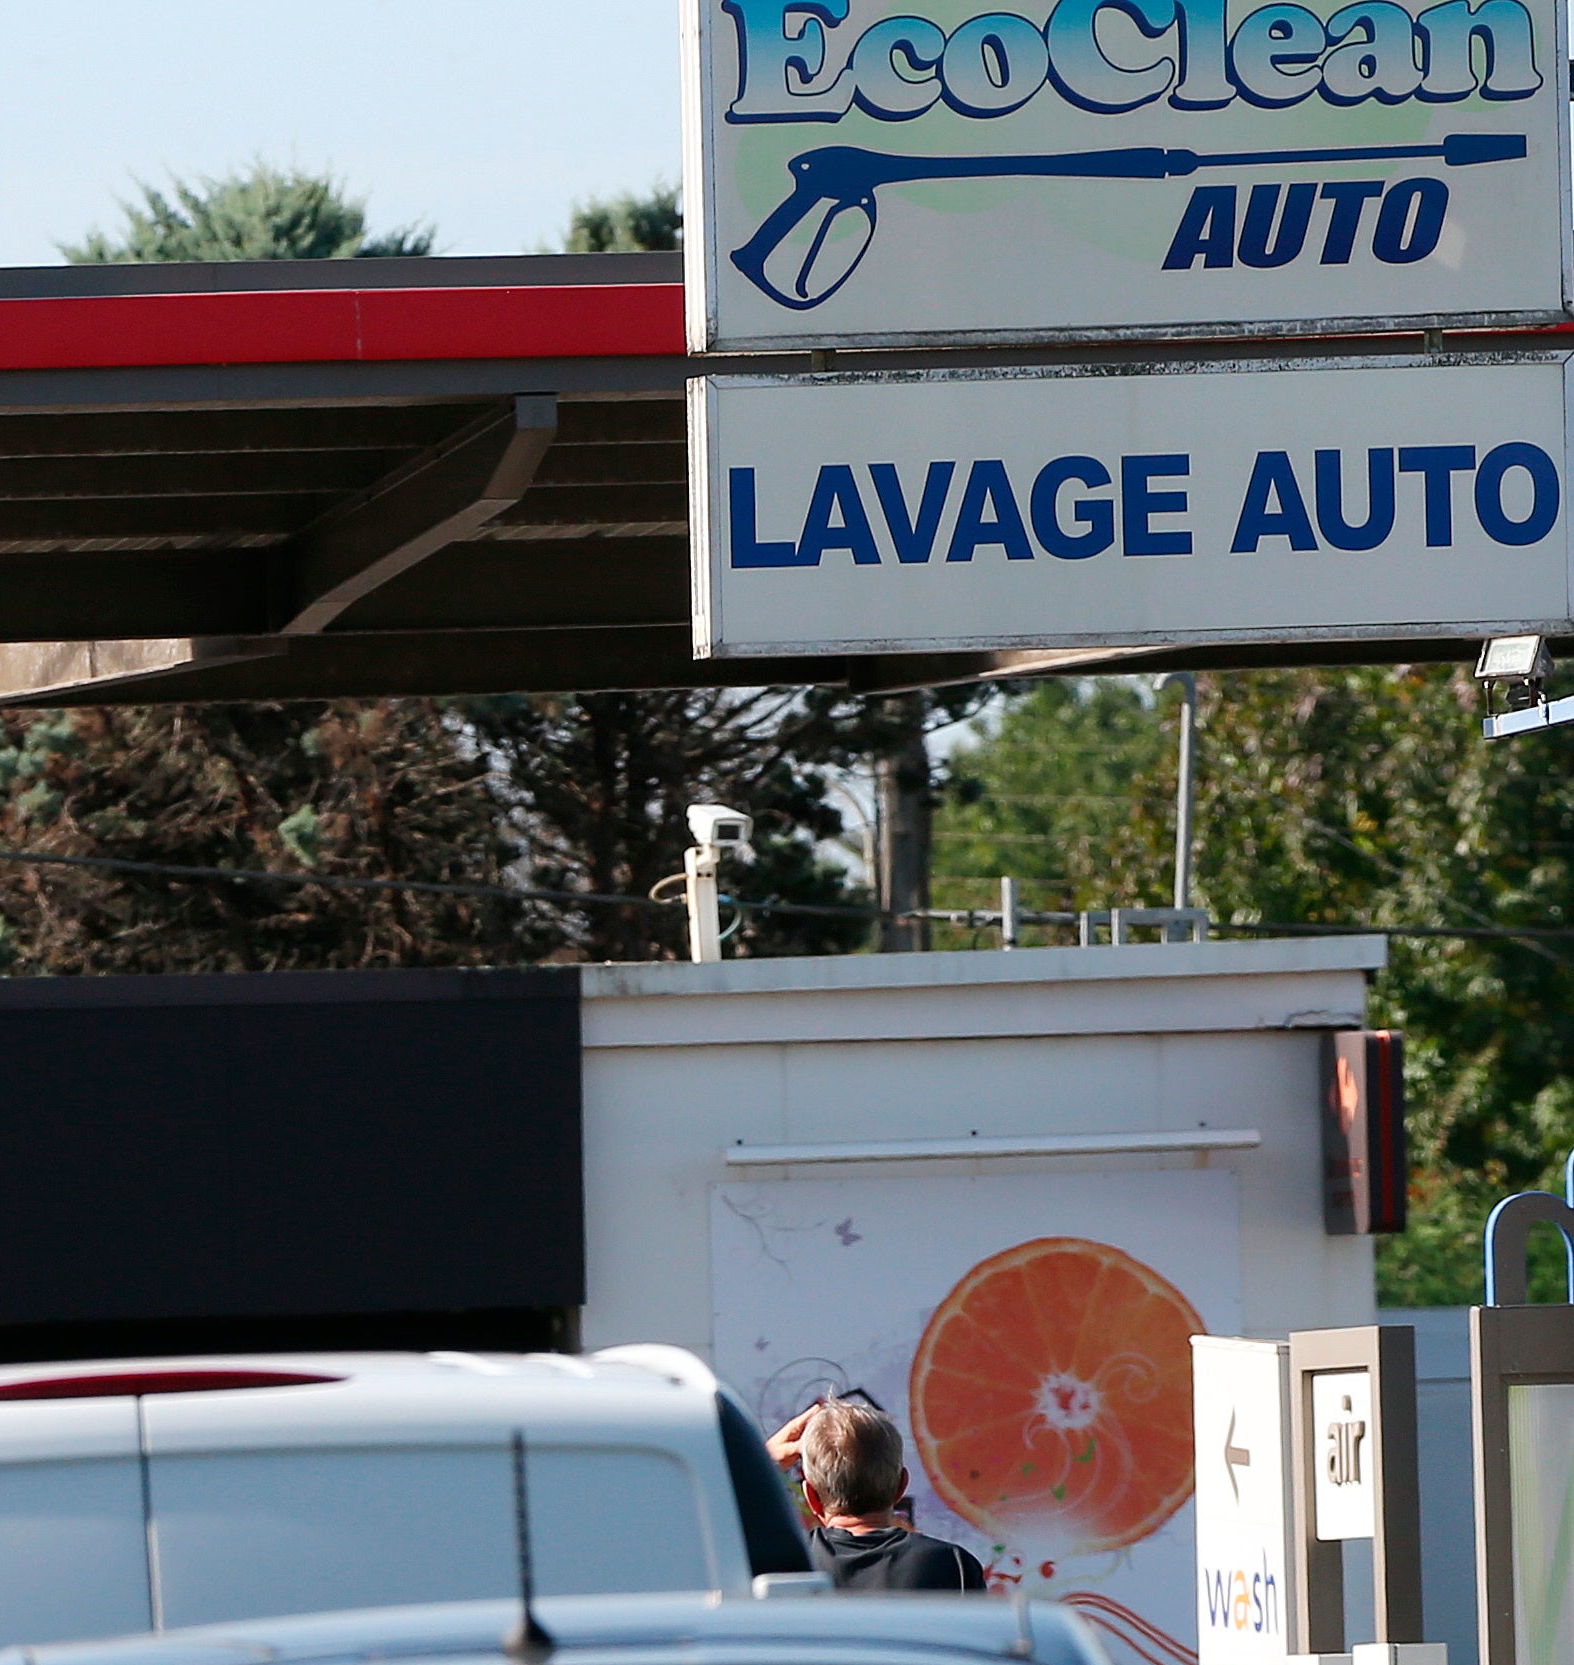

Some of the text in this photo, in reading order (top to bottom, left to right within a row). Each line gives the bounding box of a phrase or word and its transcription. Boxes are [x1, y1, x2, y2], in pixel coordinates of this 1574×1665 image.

[725, 0, 1543, 124] EcoClean
[1162, 178, 1451, 271] AUTO
[729, 442, 1561, 570] LAVAGE AUTO
[1326, 1394, 1366, 1486] air
[1205, 1547, 1279, 1635] wash
